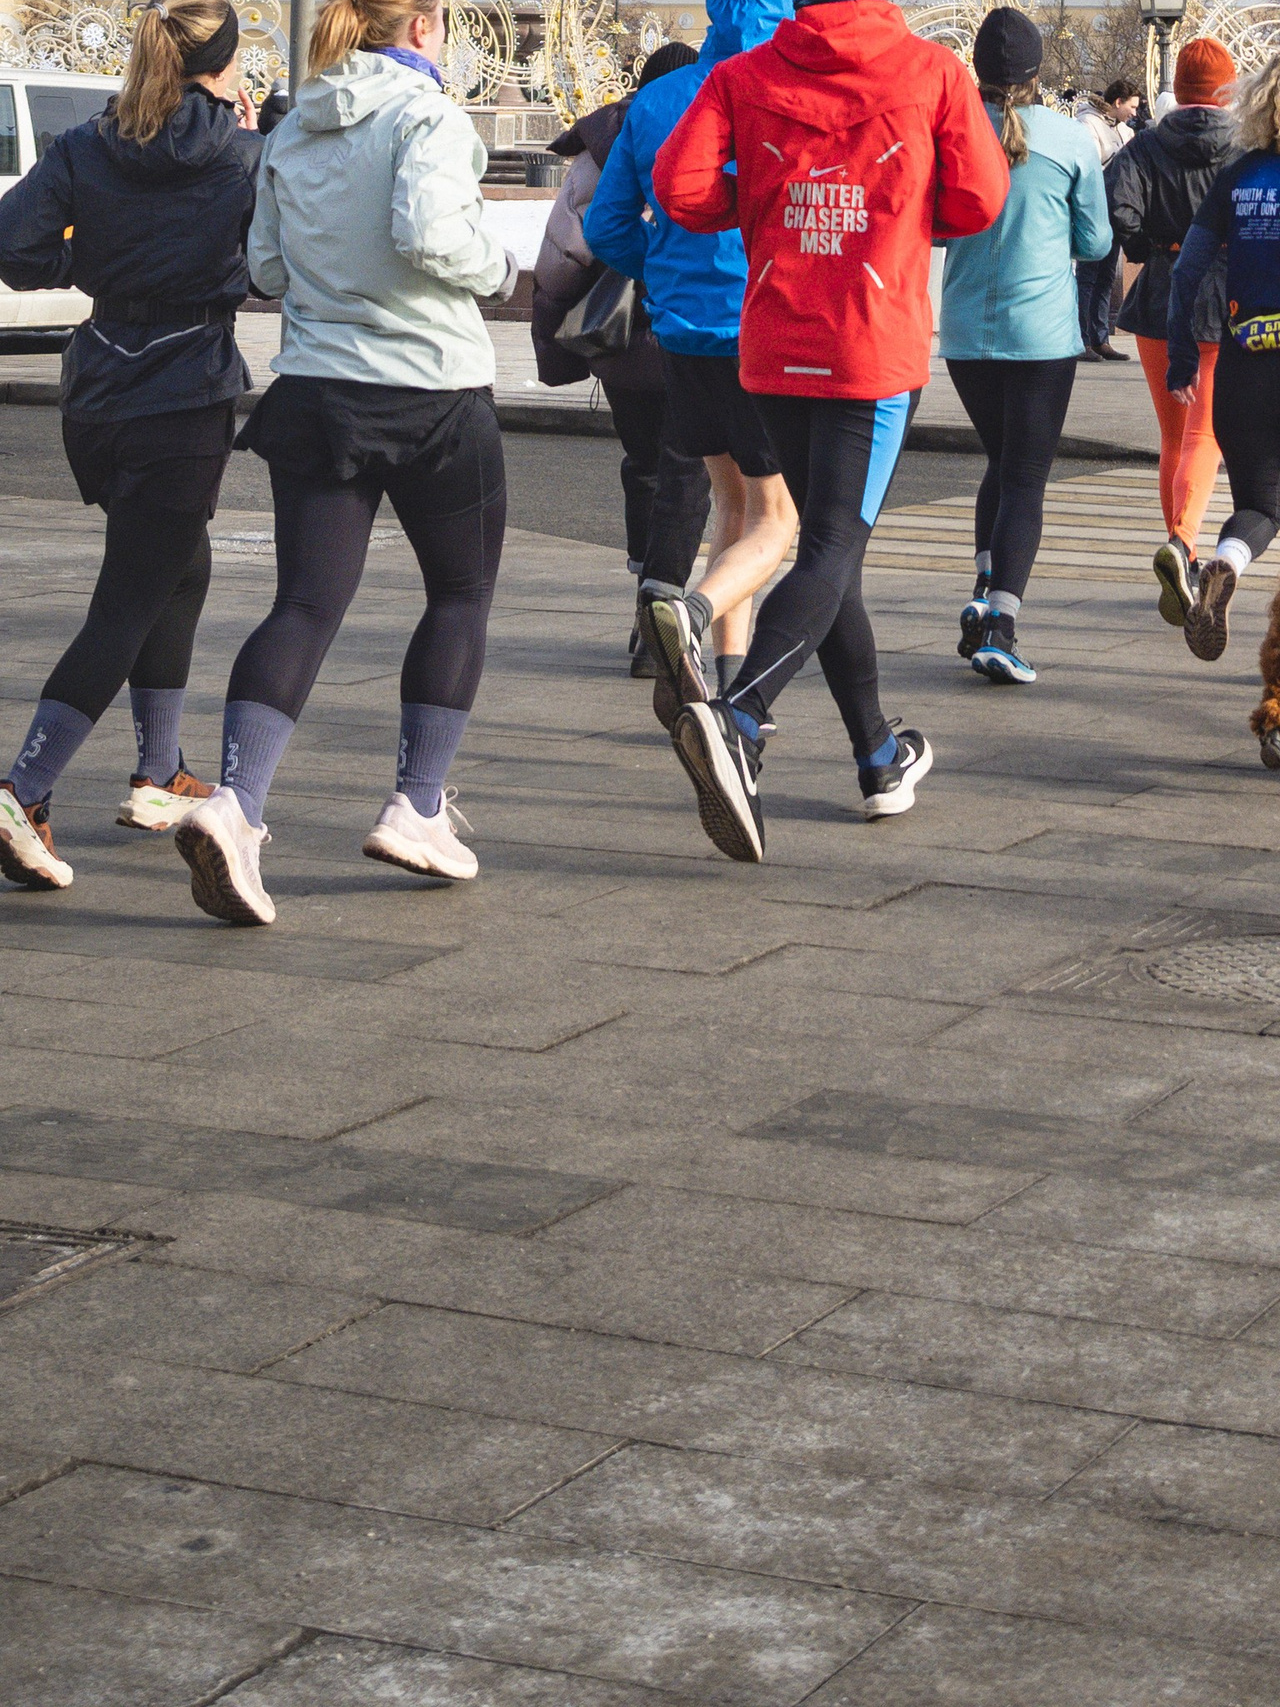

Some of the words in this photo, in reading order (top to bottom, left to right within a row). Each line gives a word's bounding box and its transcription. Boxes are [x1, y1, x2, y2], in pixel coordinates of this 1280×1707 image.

[788, 183, 865, 208] WINTER
[784, 205, 869, 232] CHASERS
[800, 231, 844, 255] MSK
